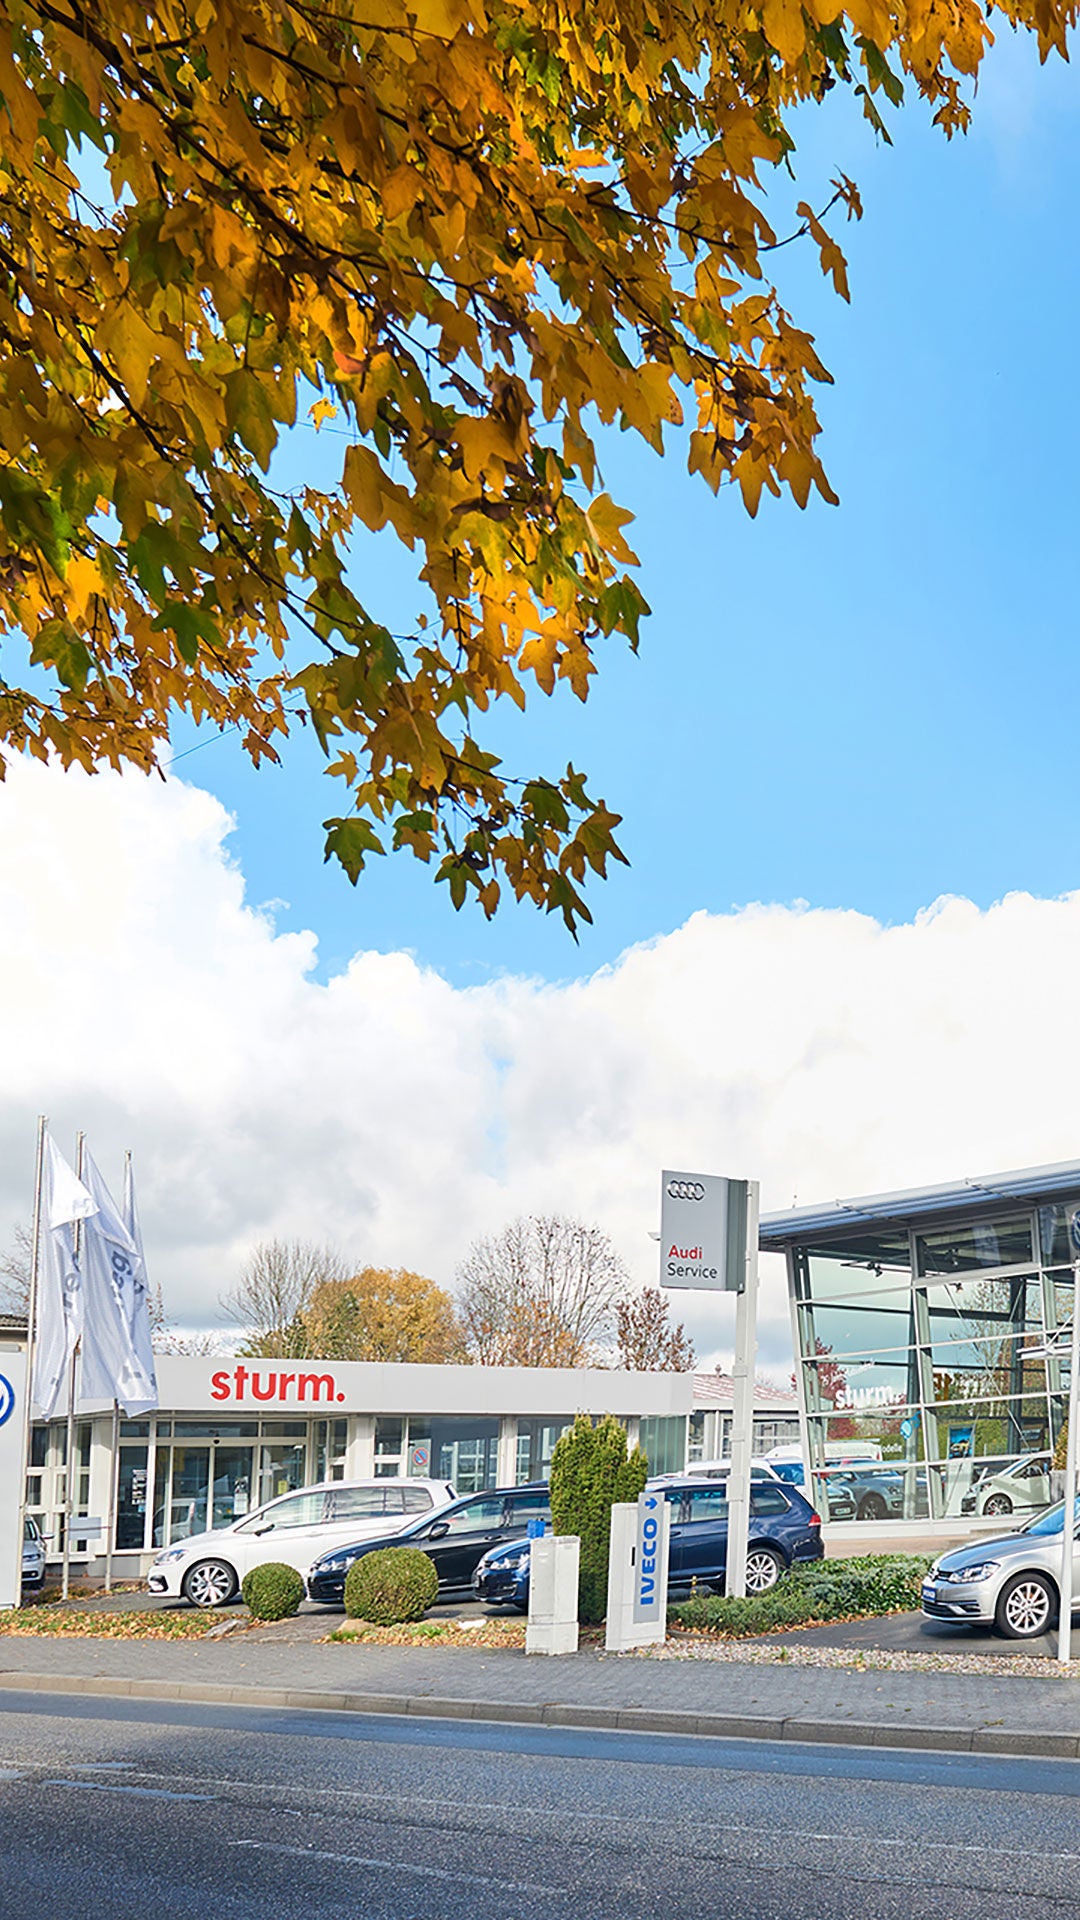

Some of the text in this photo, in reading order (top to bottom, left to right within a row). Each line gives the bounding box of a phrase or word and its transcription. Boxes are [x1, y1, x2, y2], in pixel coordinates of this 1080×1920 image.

[668, 1244, 703, 1259] Audi
[667, 1262, 718, 1279] Service
[210, 1365, 345, 1403] sturm.
[641, 1517, 658, 1605] IVECO
